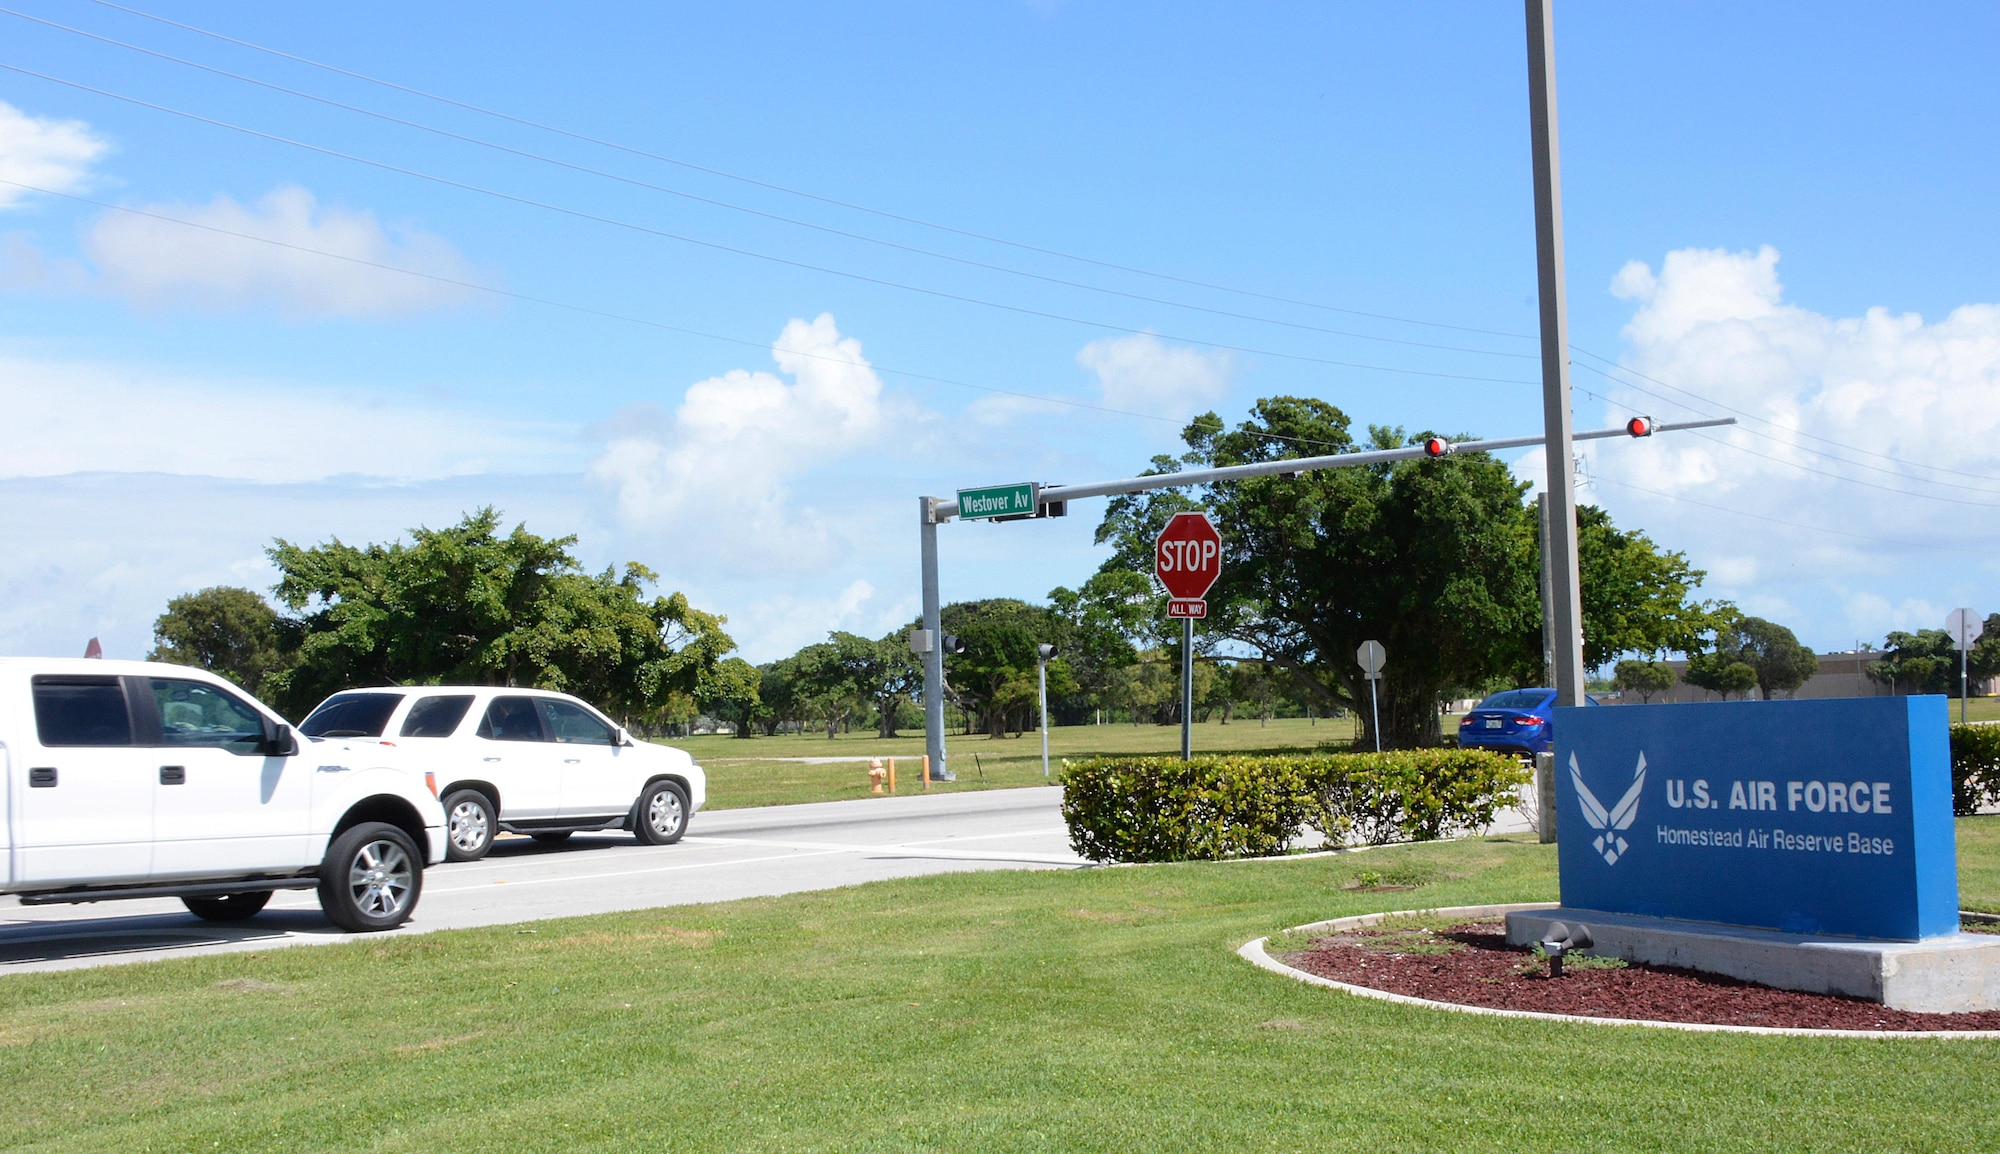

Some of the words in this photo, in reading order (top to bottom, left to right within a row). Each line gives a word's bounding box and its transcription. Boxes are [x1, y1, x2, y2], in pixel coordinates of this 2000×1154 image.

[962, 494, 1009, 514] Westover
[1014, 491, 1028, 508] Av
[1160, 540, 1216, 572] STOP
[1170, 604, 1186, 615] ALL
[1188, 604, 1203, 615] WAY
[1666, 779, 1718, 809] U.S.
[1728, 780, 1777, 811] AIR
[1787, 780, 1892, 814] FORCE
[1657, 824, 1743, 848] Homestead
[1747, 828, 1769, 849] Air
[1773, 829, 1844, 853] Reserve
[1847, 831, 1894, 855] Base
